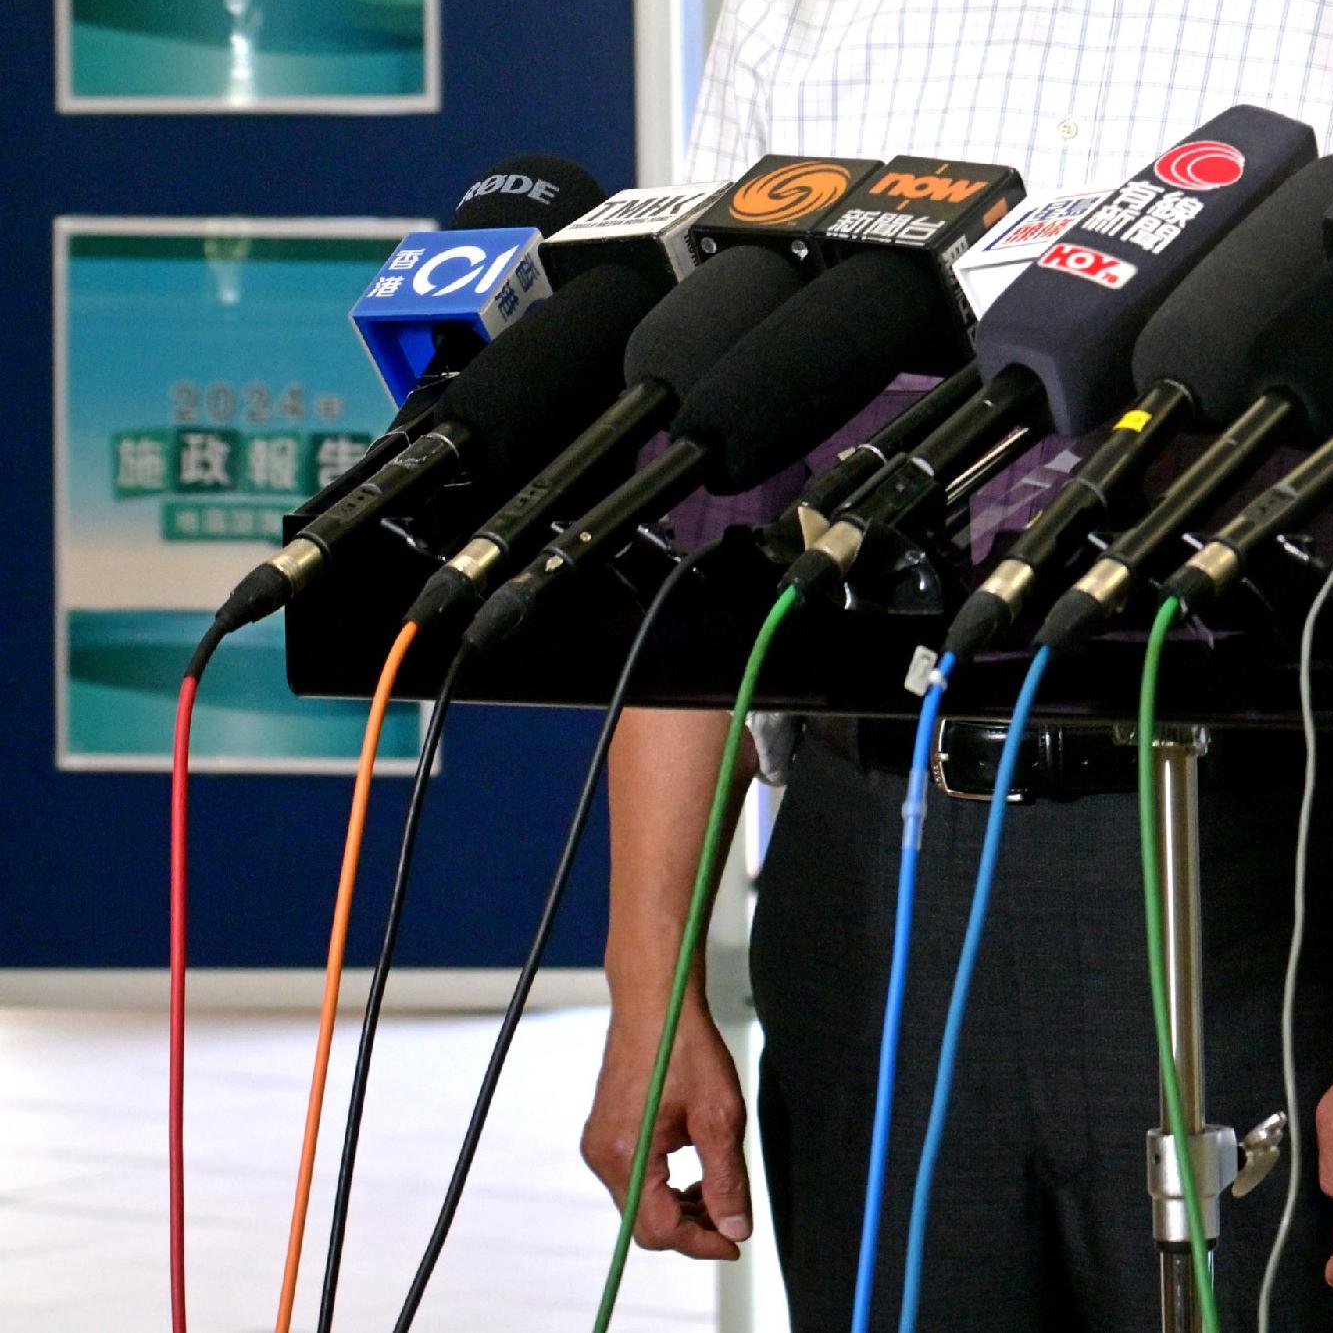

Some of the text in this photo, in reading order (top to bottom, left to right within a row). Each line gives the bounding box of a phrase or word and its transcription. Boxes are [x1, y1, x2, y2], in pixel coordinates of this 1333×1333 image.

[585, 193, 706, 222] TMHK
[868, 172, 989, 204] now
[1112, 180, 1205, 229] 有線
[826, 208, 947, 247] 新聞台
[1081, 204, 1182, 255] 新聞
[366, 248, 427, 298] 香港
[1044, 244, 1121, 277] HOY
